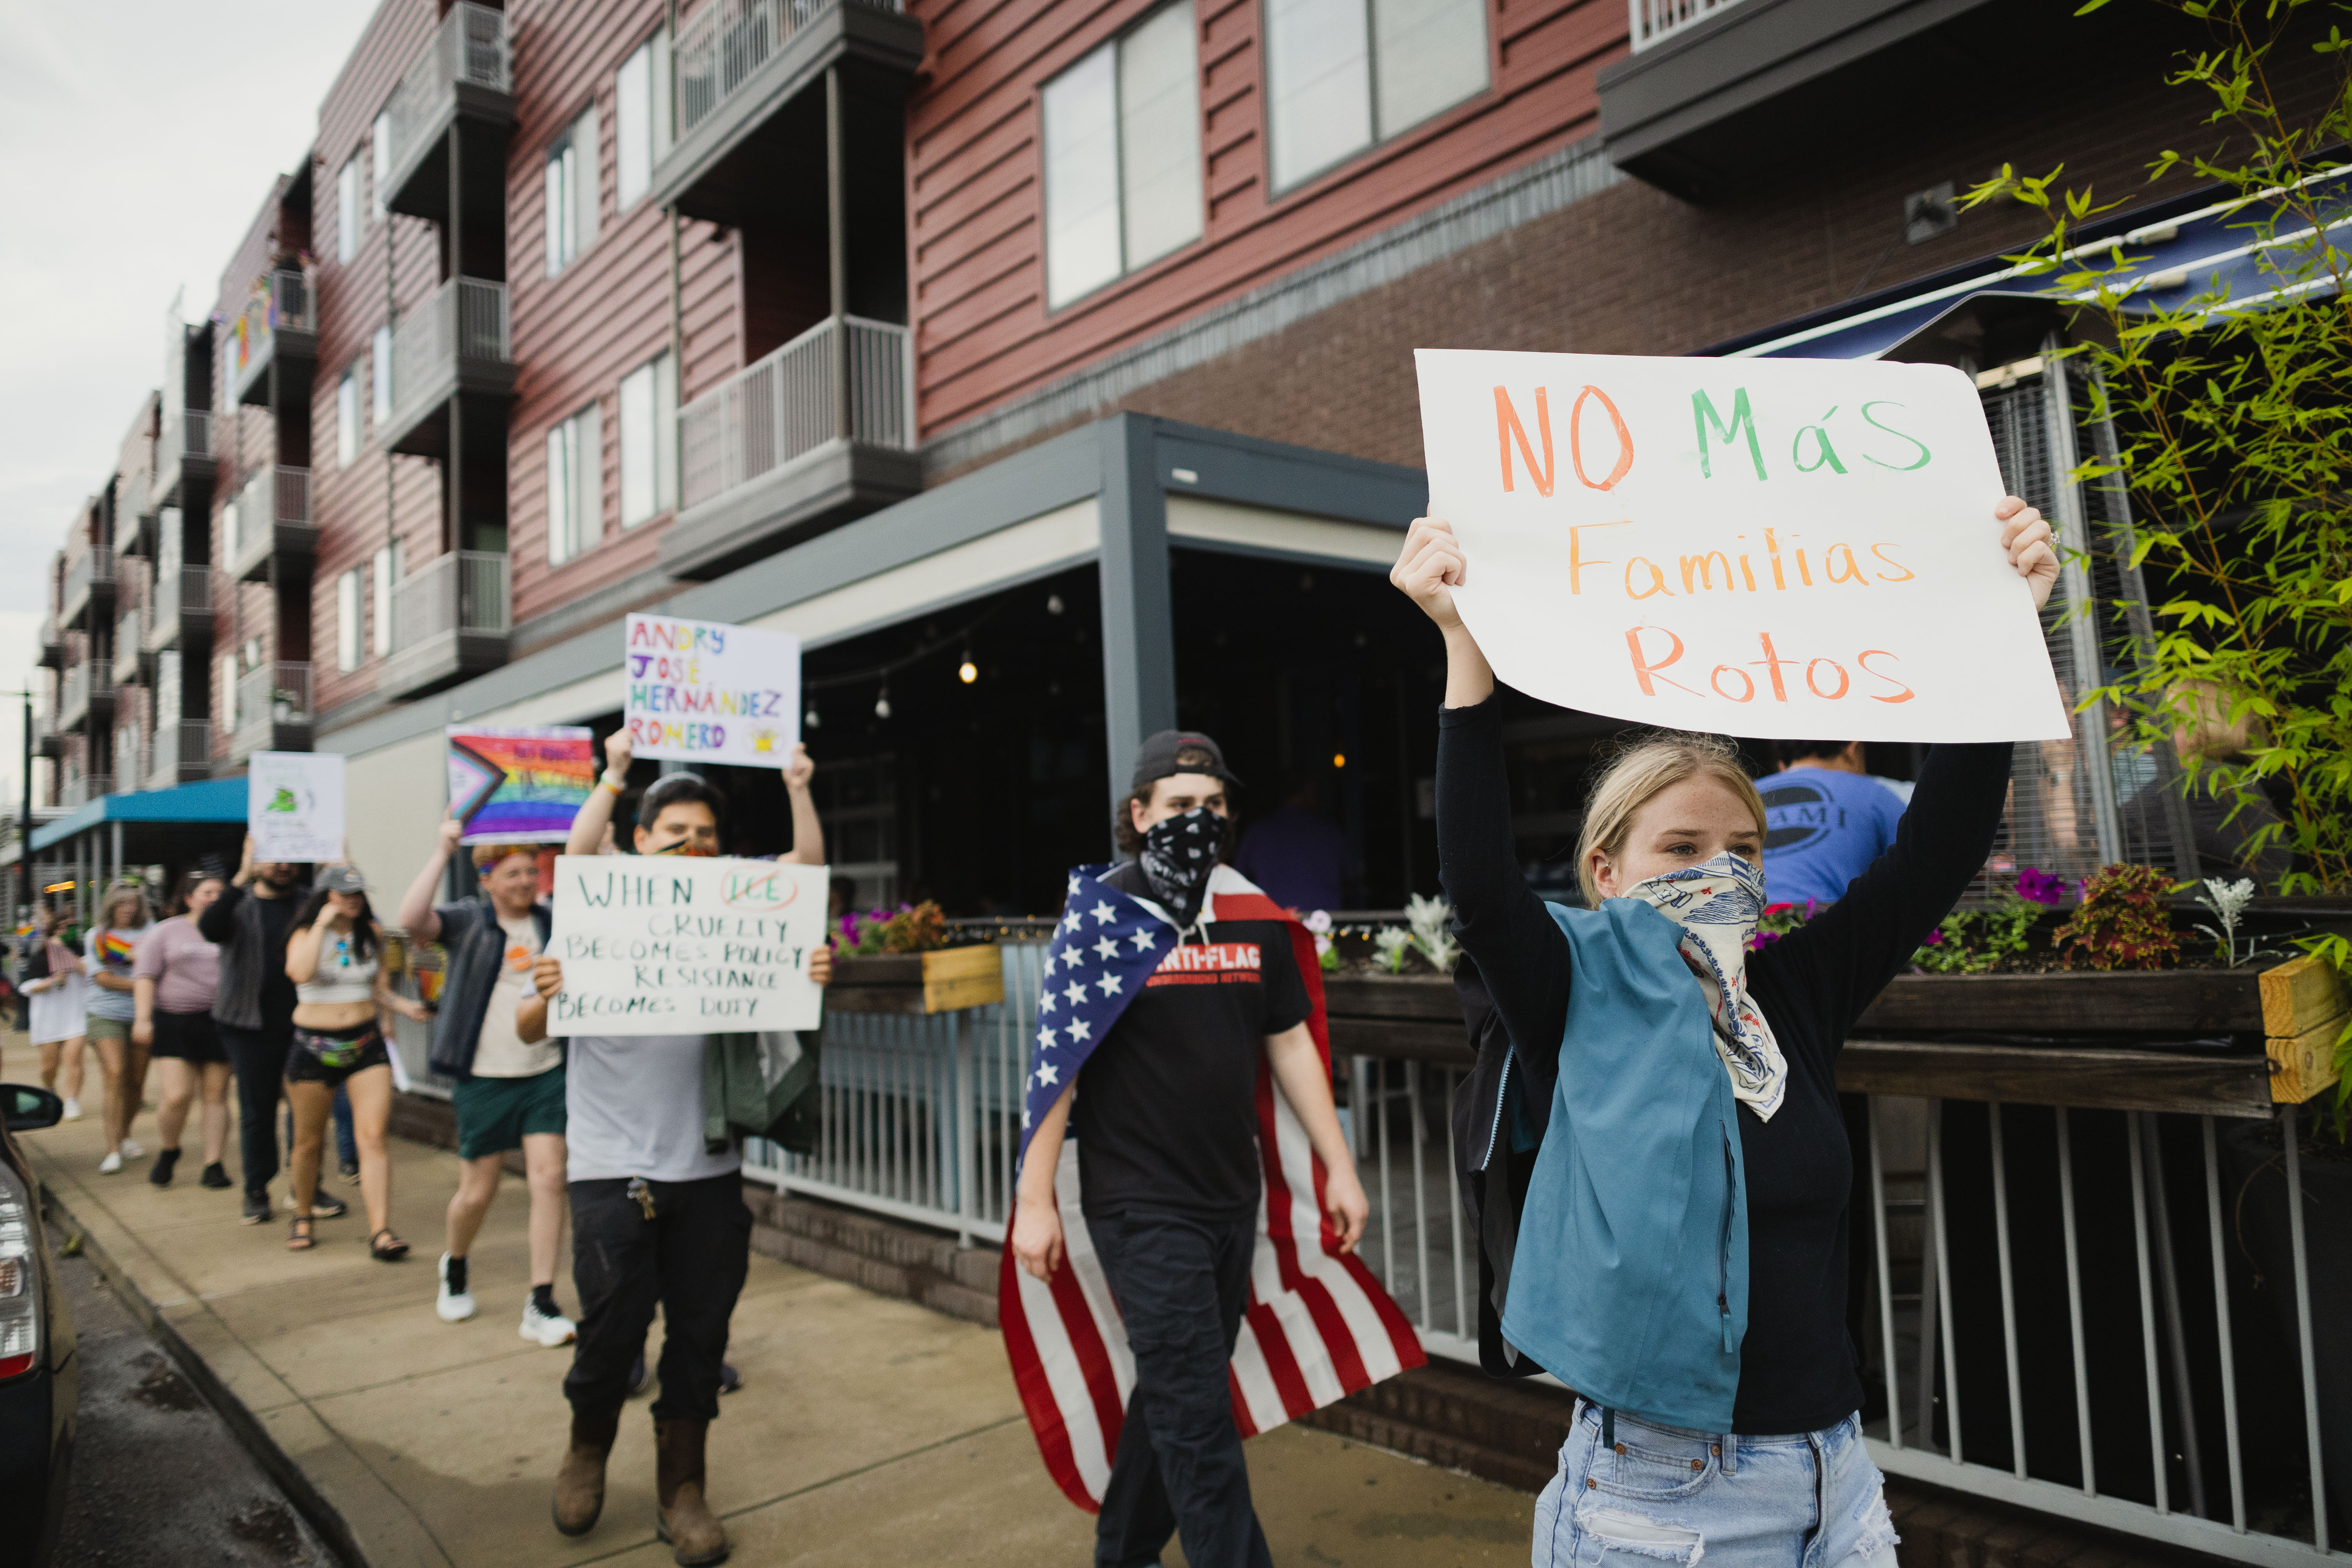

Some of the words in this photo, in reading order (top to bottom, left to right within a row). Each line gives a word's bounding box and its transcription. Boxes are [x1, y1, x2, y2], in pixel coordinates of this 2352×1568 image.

[1494, 385, 1633, 497] NO
[1570, 521, 1915, 600] Familias
[631, 622, 724, 654] ANDRY
[1626, 626, 1914, 703] Rotos
[1767, 806, 1845, 828] AMI
[578, 872, 692, 907] WHEN
[728, 874, 781, 901] ICE
[649, 912, 788, 942] CRUELTY
[724, 943, 803, 969] POLICY
[1156, 946, 1260, 971] NTI-FLAG
[633, 964, 779, 990] RESISTANCE
[700, 996, 759, 1017] DUTY
